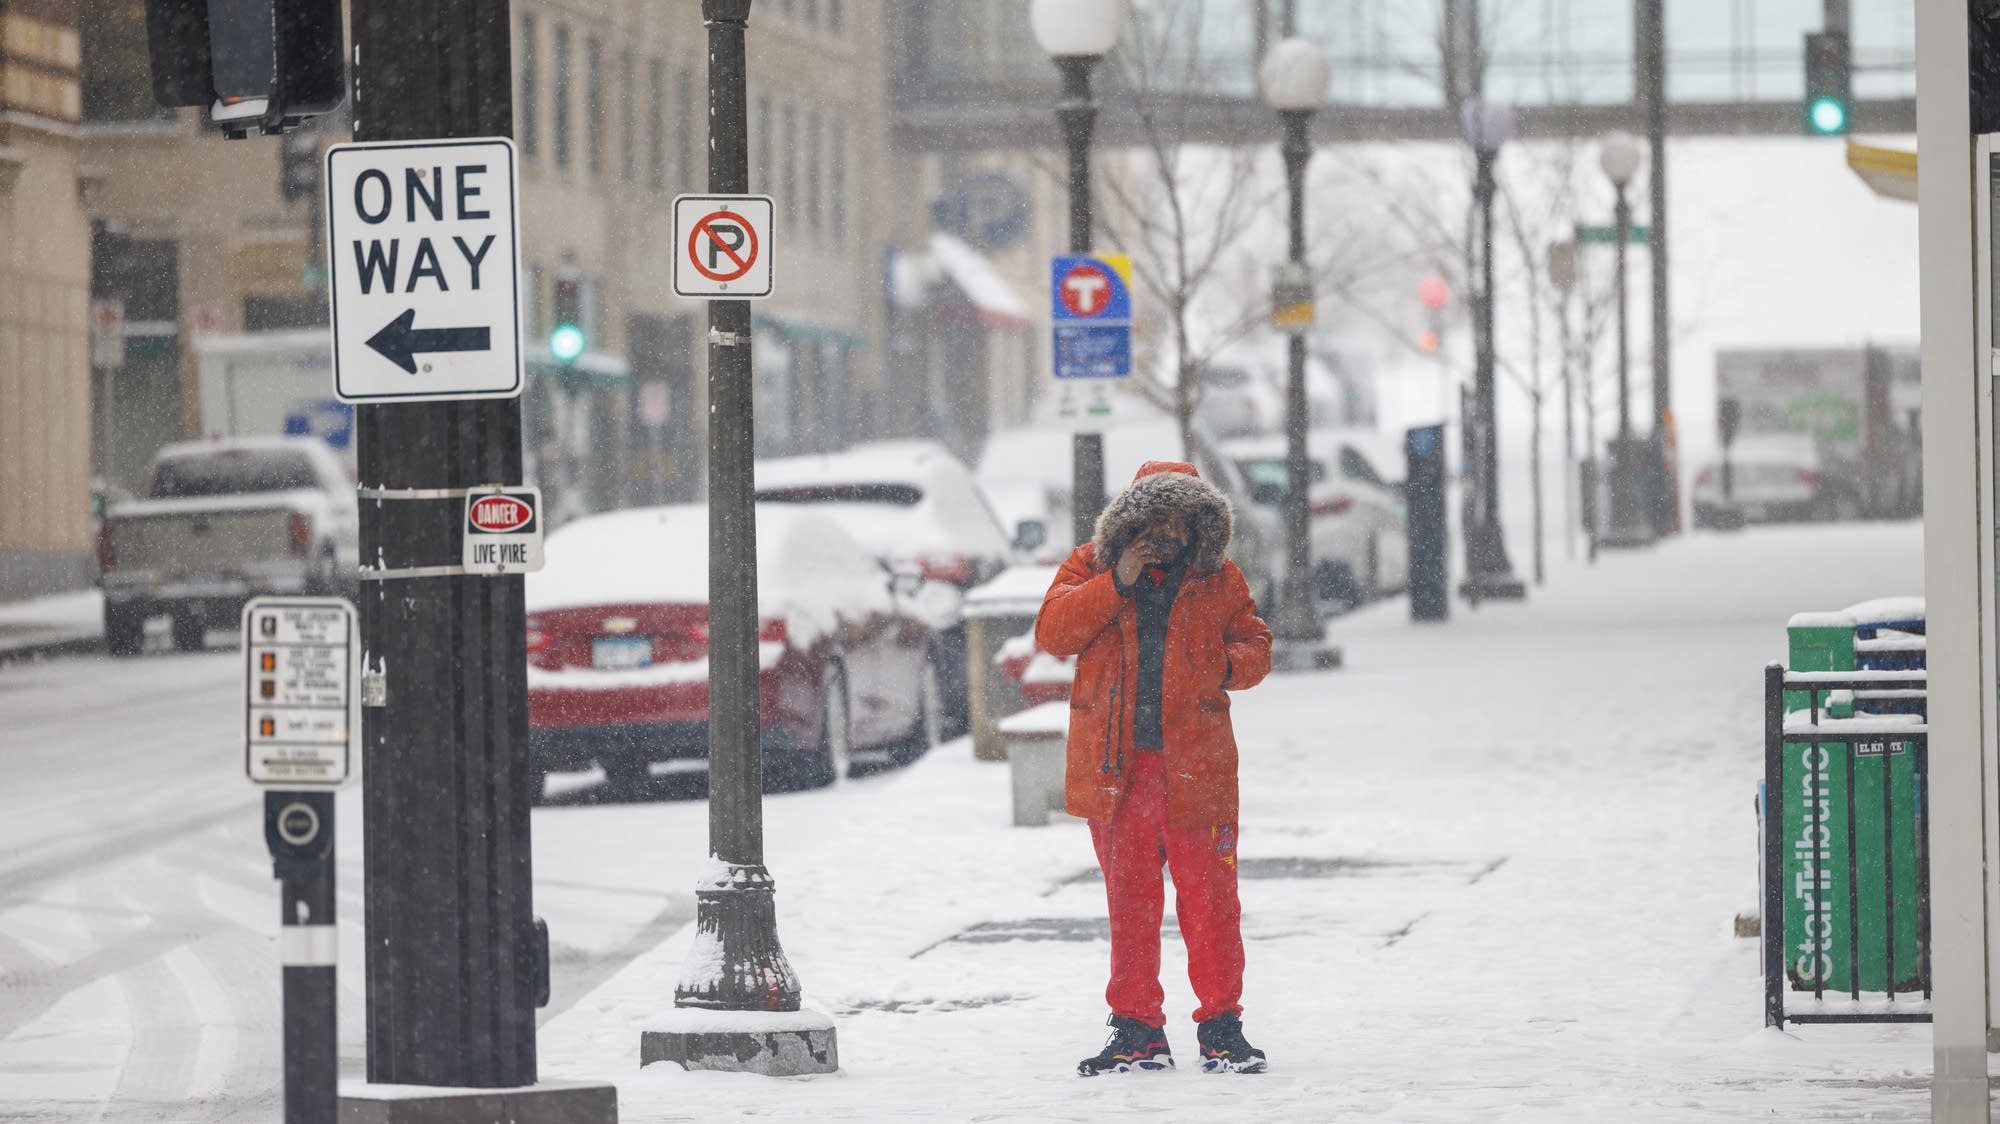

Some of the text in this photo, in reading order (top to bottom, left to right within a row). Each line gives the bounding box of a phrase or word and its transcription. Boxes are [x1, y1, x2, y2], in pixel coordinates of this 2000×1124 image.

[353, 164, 491, 225] ONE
[352, 234, 497, 295] WAY
[708, 224, 745, 269] P
[1066, 276, 1106, 312] T
[474, 543, 497, 564] LIVE
[1859, 743, 1870, 753] EL
